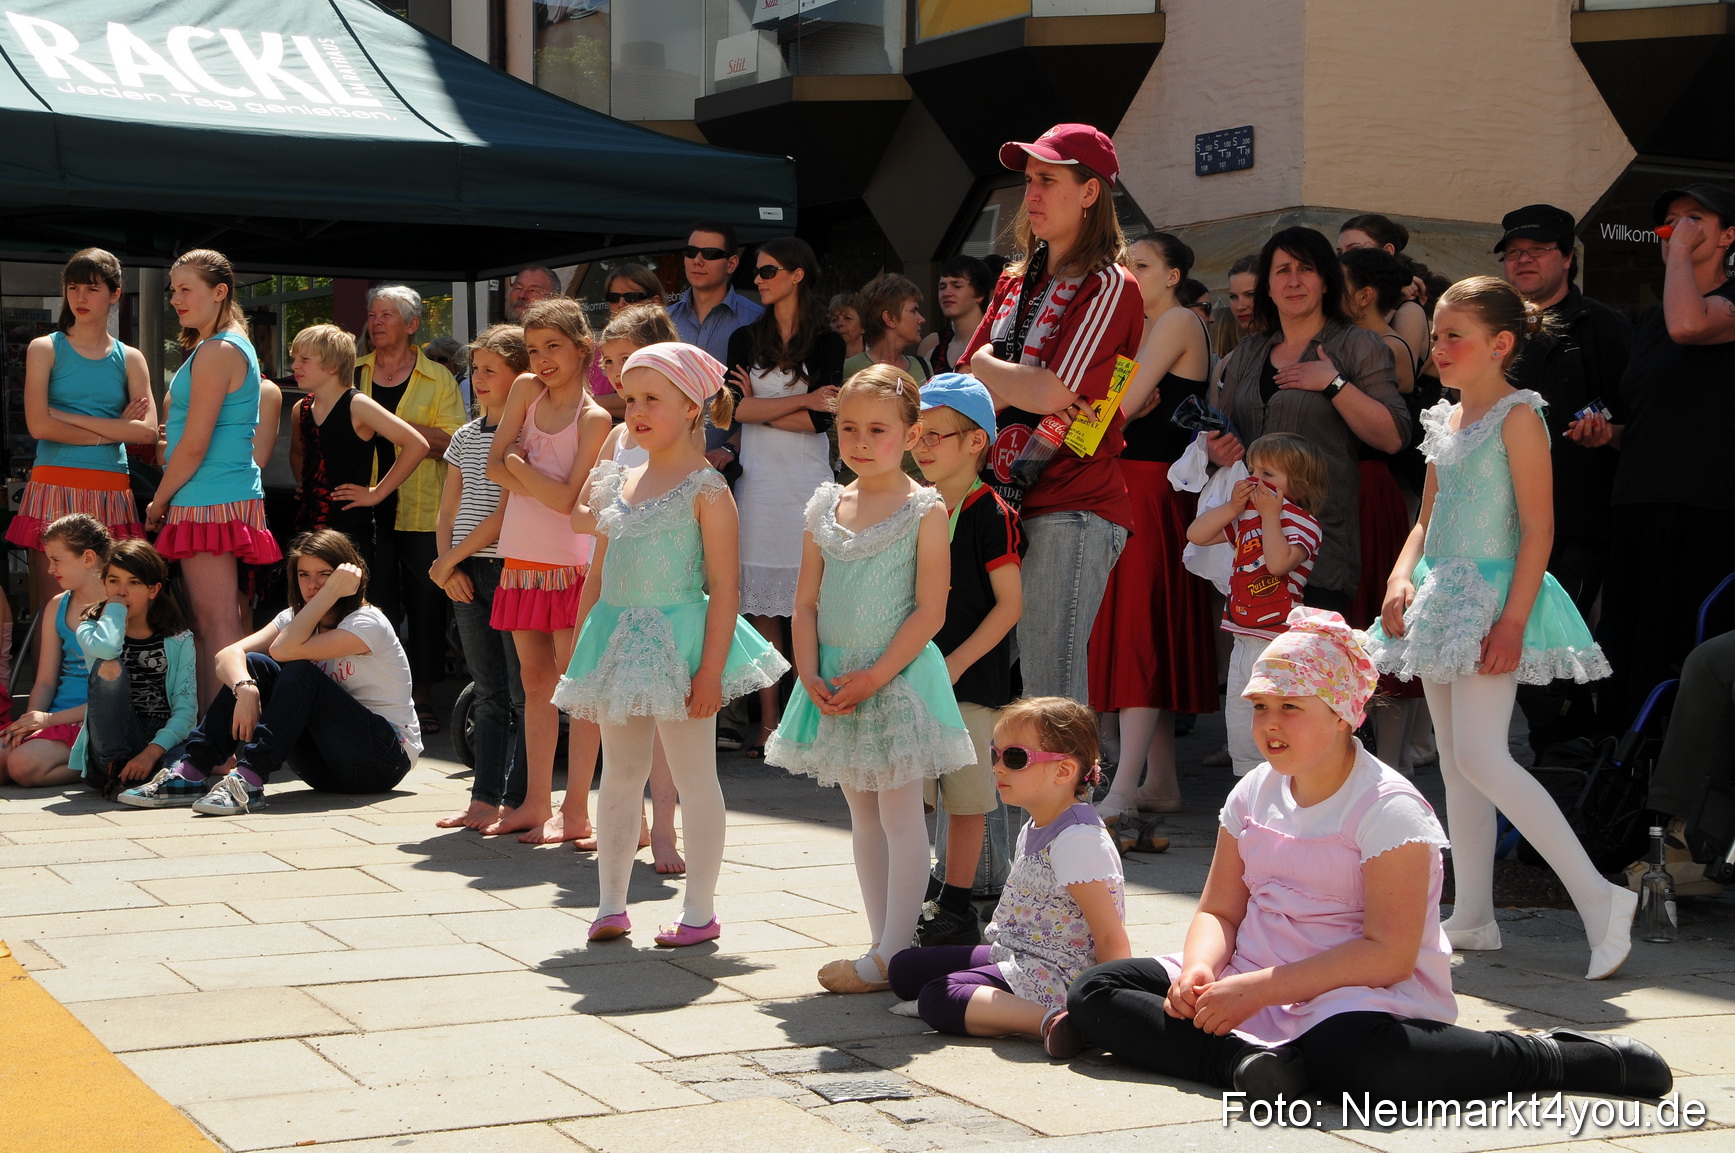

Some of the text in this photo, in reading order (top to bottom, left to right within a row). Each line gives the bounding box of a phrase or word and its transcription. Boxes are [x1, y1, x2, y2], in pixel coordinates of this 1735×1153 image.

[317, 38, 361, 81] RATHAUS
[726, 58, 747, 75] Silit
[57, 81, 398, 121] Jeden Tag genießen.
